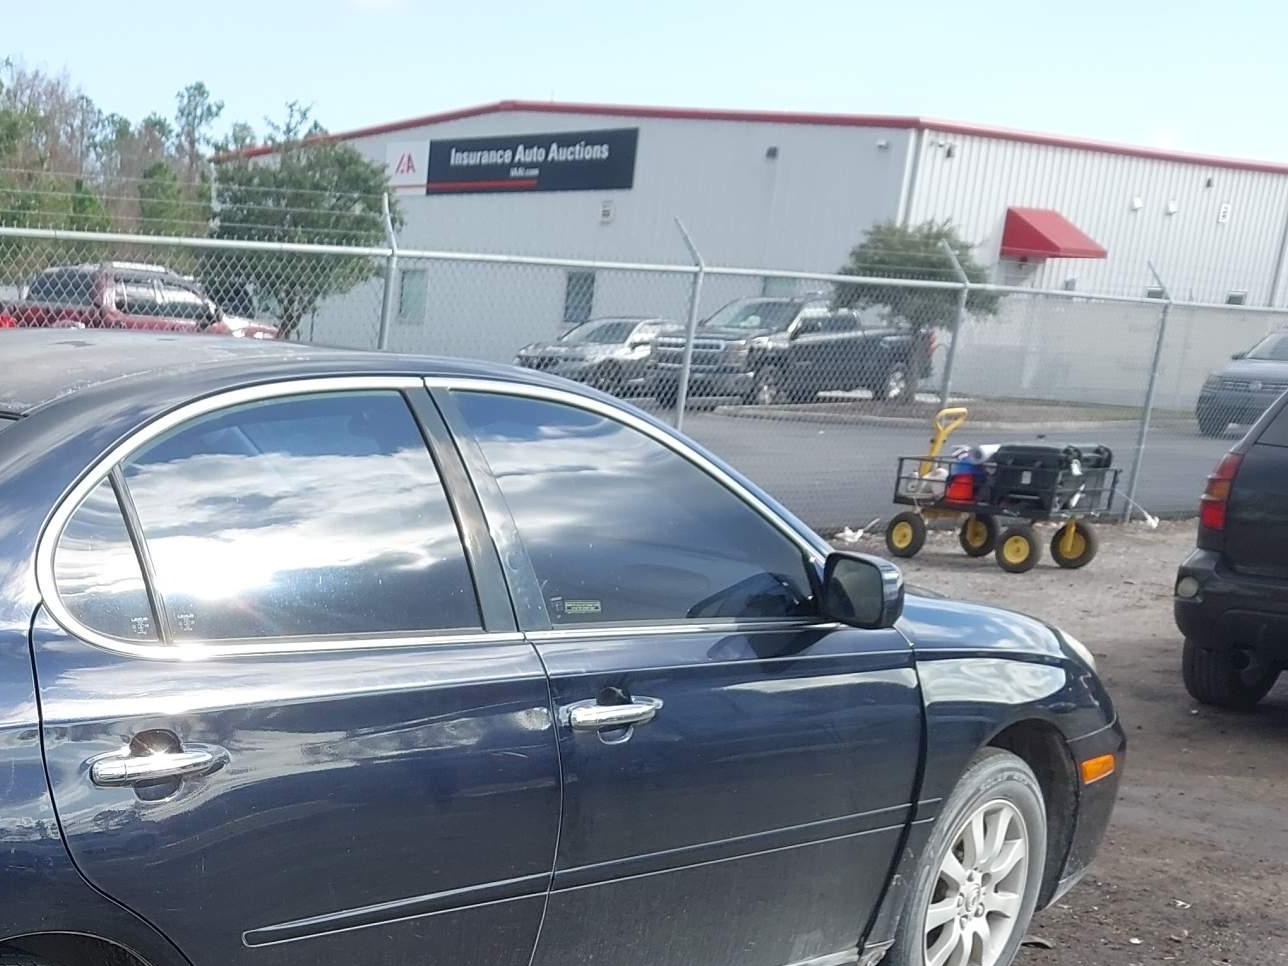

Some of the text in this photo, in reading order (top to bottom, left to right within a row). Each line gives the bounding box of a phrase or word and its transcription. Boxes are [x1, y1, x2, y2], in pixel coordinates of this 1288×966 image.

[450, 141, 609, 166] Insurance Auto Auctions
